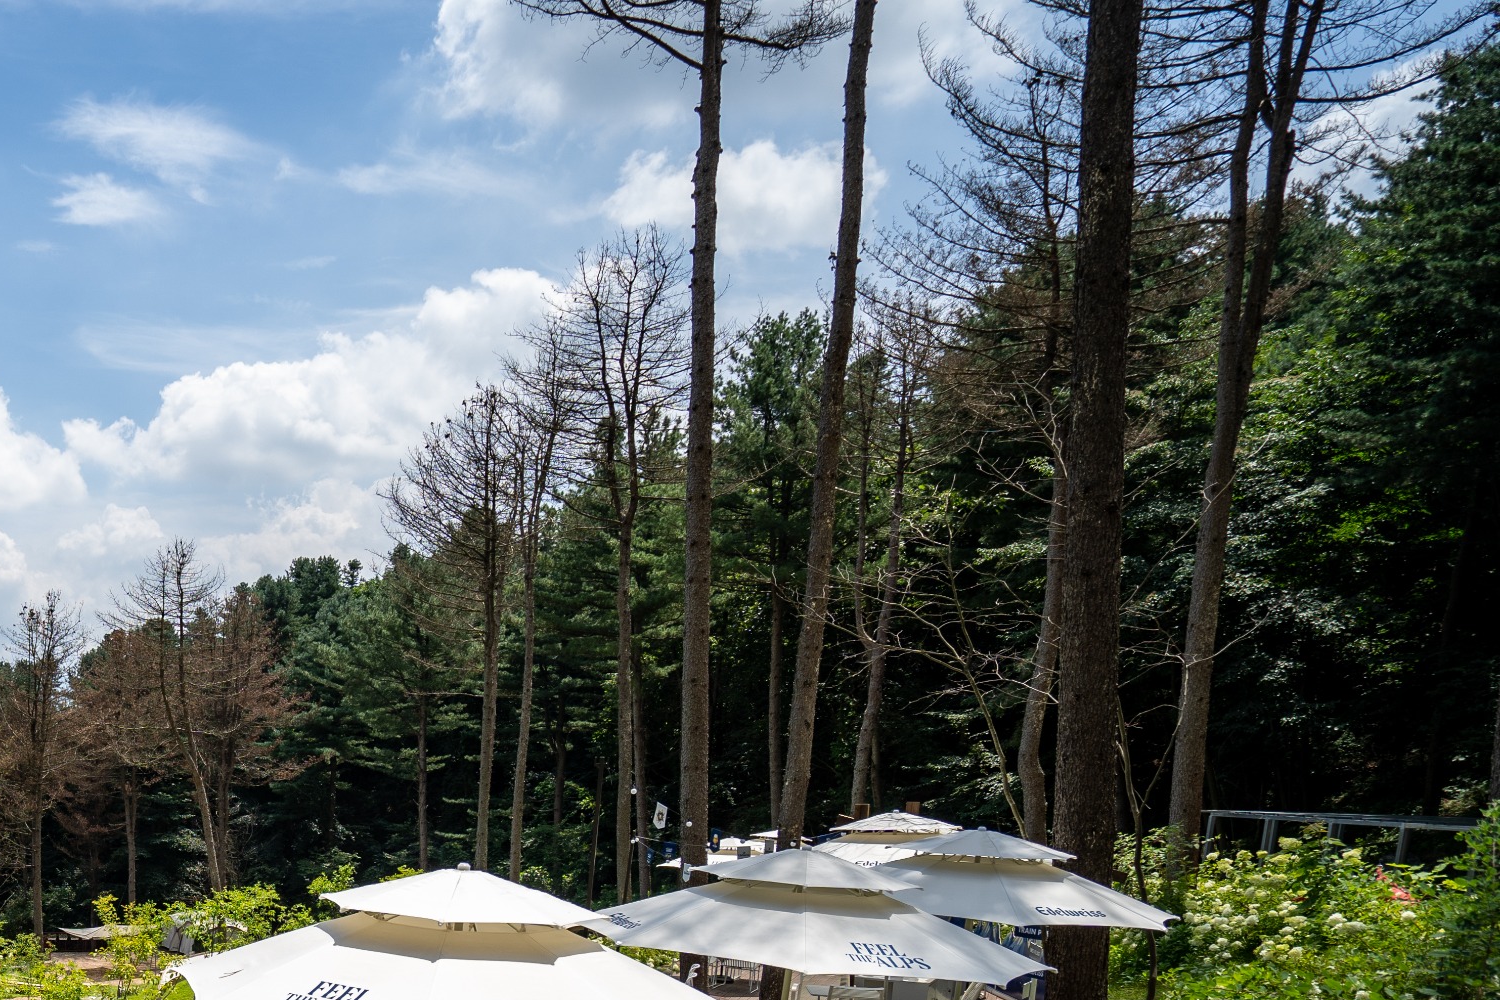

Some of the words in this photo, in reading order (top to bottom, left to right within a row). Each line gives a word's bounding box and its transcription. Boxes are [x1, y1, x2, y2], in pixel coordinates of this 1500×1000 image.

[1035, 906, 1106, 918] Edelweiss
[849, 942, 907, 956] FEEL
[845, 953, 876, 963] THE
[876, 956, 931, 970] ALPS
